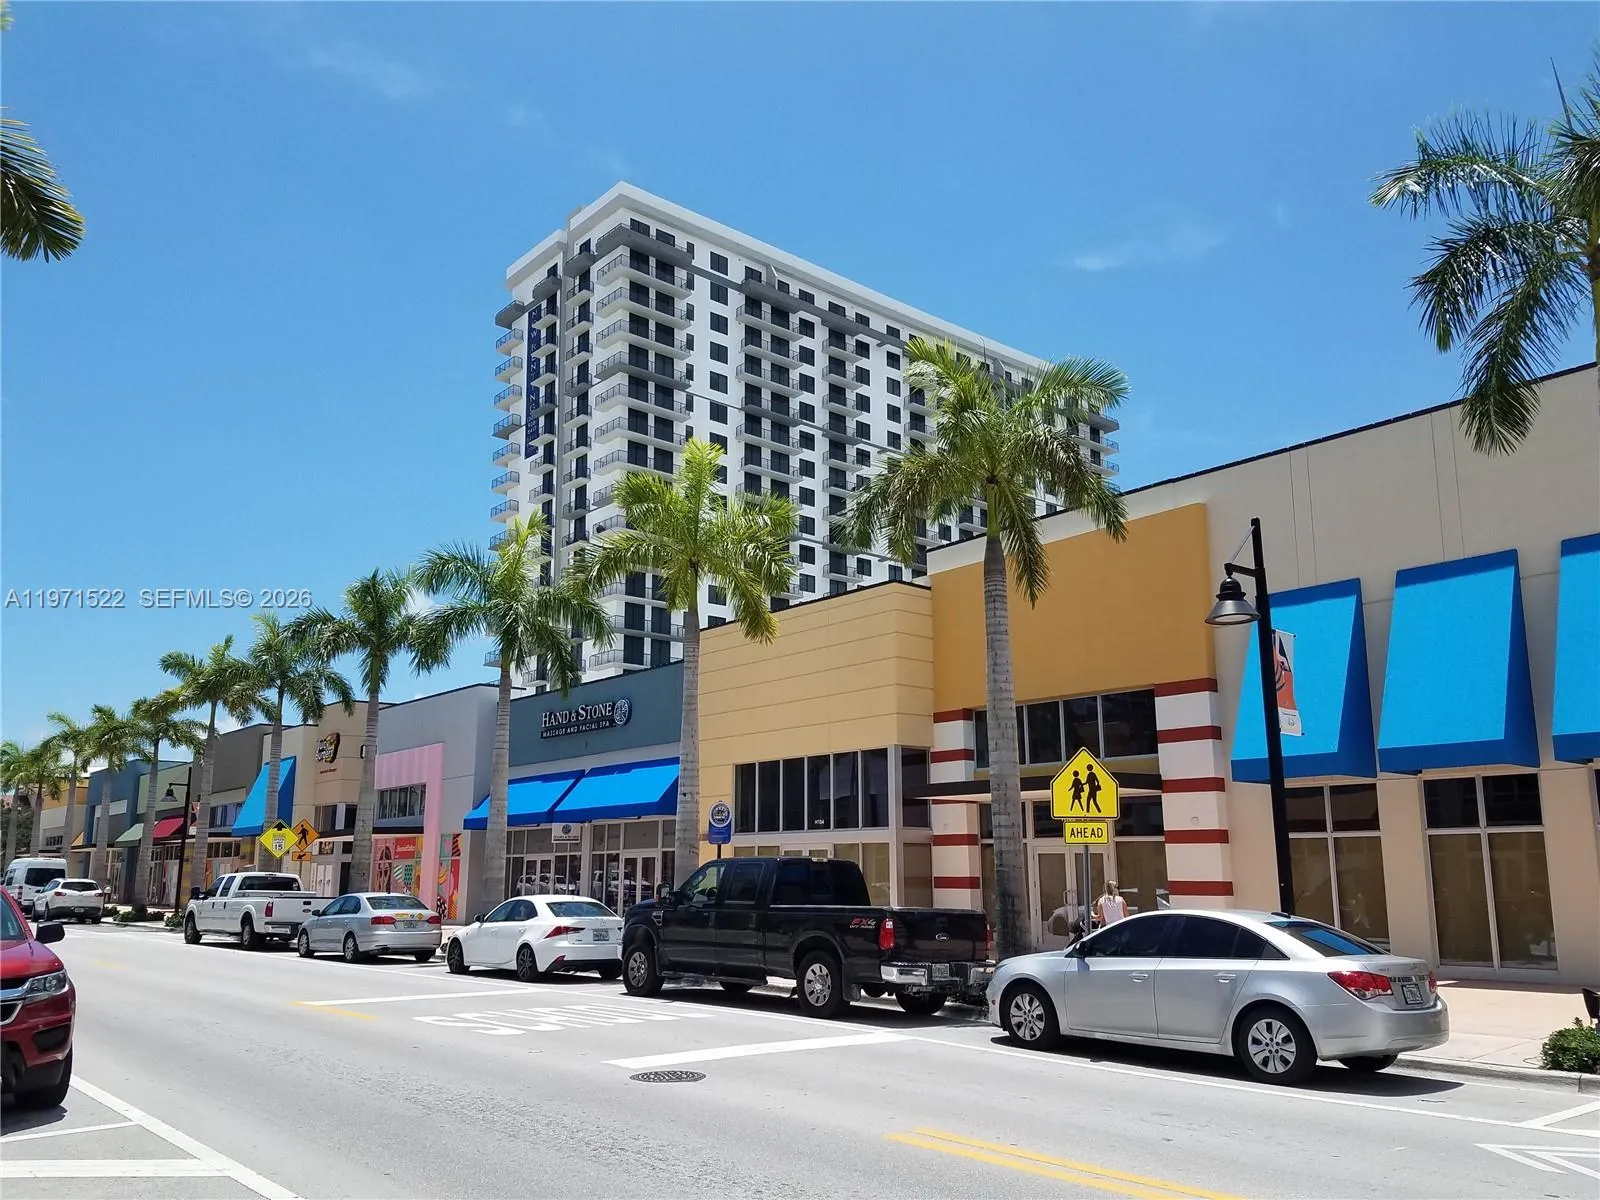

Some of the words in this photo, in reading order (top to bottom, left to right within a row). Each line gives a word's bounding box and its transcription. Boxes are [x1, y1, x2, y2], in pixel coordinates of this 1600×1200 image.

[542, 711, 569, 727] HAND
[570, 709, 577, 722] &
[578, 702, 612, 720] STONE
[543, 728, 566, 737] MASSAGE
[579, 722, 598, 732] FACIAL
[599, 720, 609, 728] SPA
[1069, 827, 1104, 839] AHEAD
[851, 918, 877, 926] FX4
